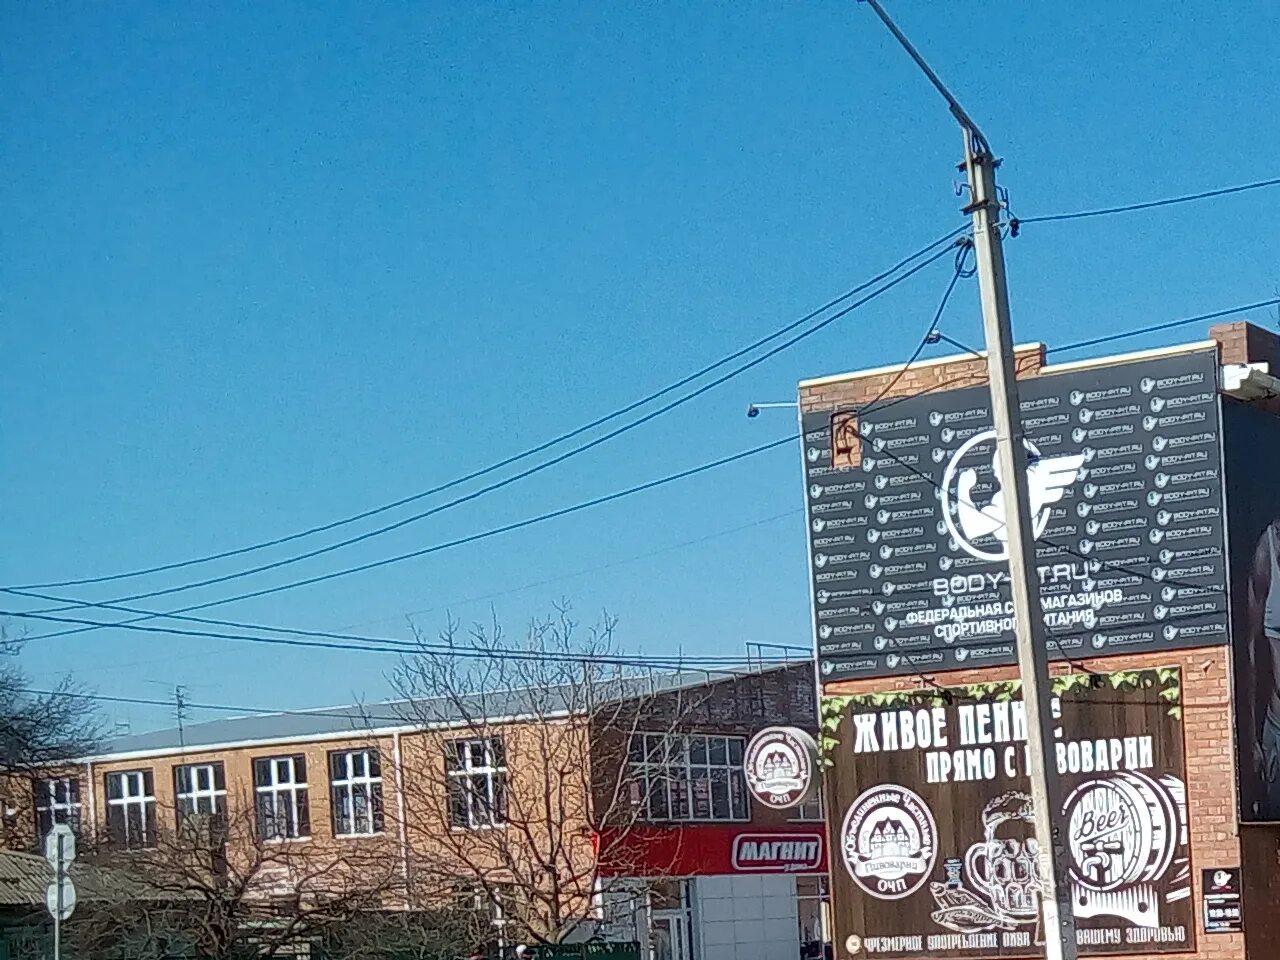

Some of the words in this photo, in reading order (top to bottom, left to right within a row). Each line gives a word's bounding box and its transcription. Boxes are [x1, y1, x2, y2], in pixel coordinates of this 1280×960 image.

[906, 603, 1002, 624] ФЕДЕРАЛЬНАЯ
[934, 617, 1018, 638] СПОРТИВНОГ
[1044, 609, 1095, 627] ИТАНИЯ
[853, 707, 948, 753] ЖИВОЕ
[926, 748, 996, 783] ПРЯМО
[1004, 746, 1017, 778] С
[1074, 804, 1129, 841] Beer
[740, 841, 818, 861] МАГНИТ
[877, 878, 907, 893] ОЧП
